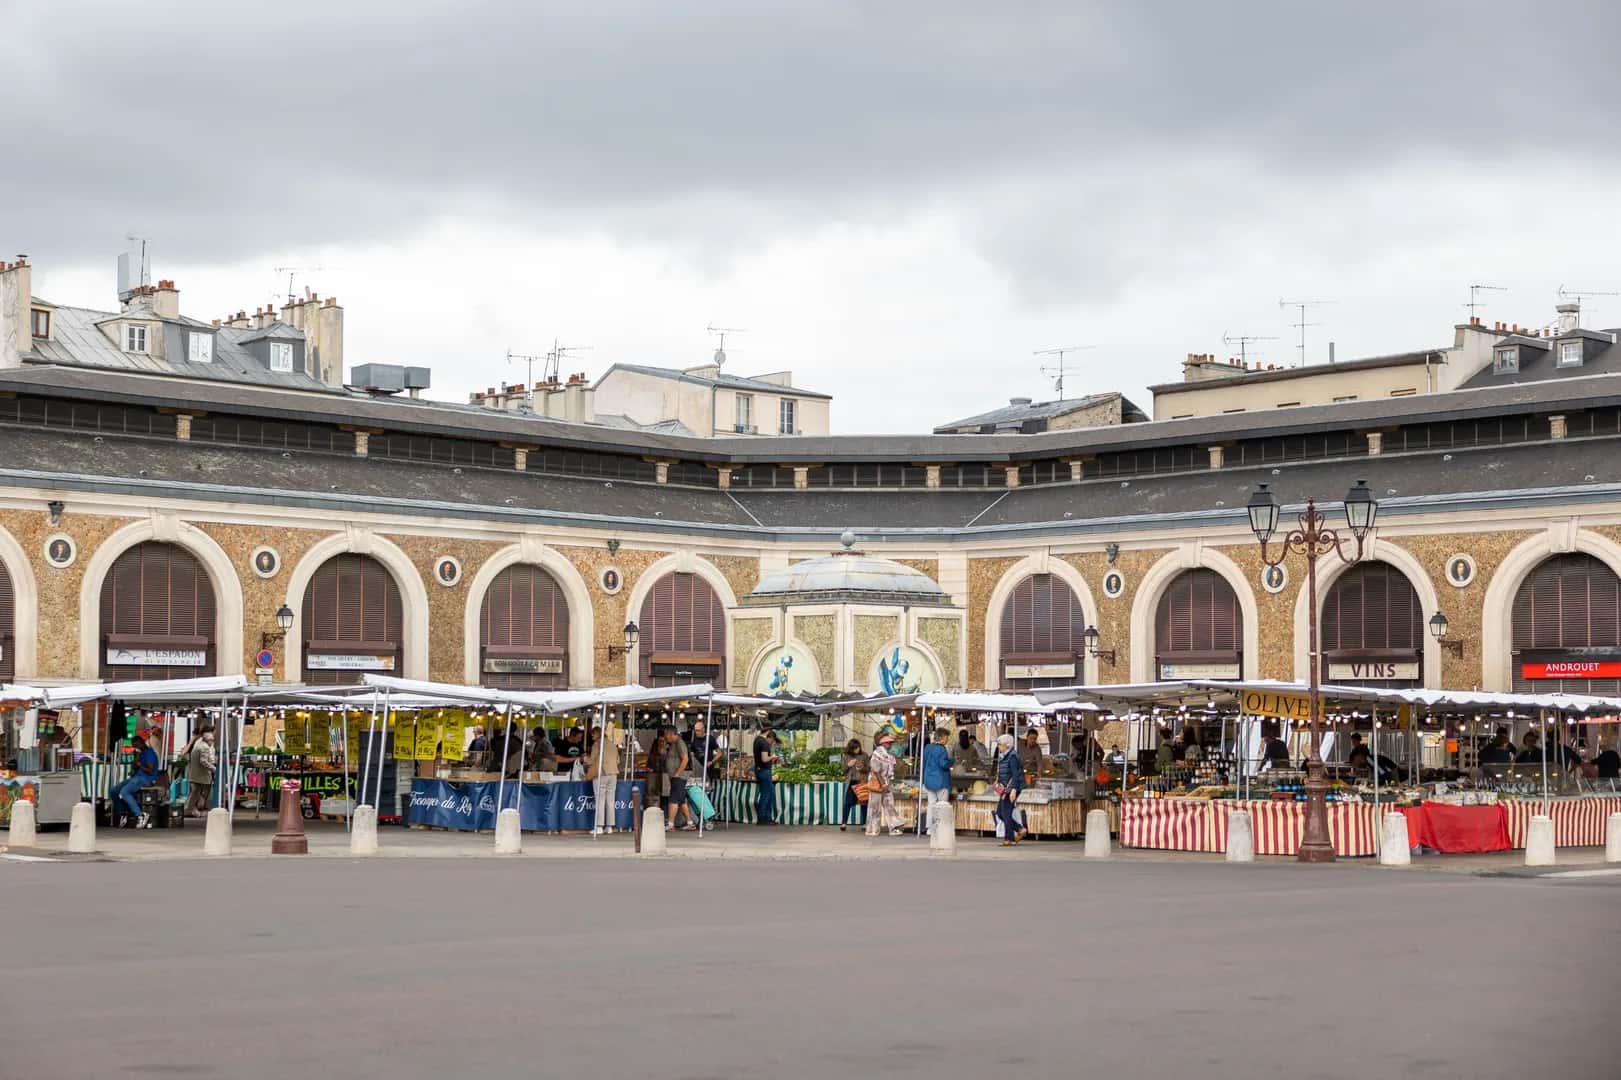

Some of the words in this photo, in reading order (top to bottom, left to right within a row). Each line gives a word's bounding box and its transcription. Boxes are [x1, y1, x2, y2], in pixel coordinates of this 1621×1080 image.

[145, 648, 200, 658] L'ESPADON
[1351, 663, 1396, 677] VINS
[1545, 663, 1600, 672] ANDROUET
[1246, 692, 1321, 717] OLIVE
